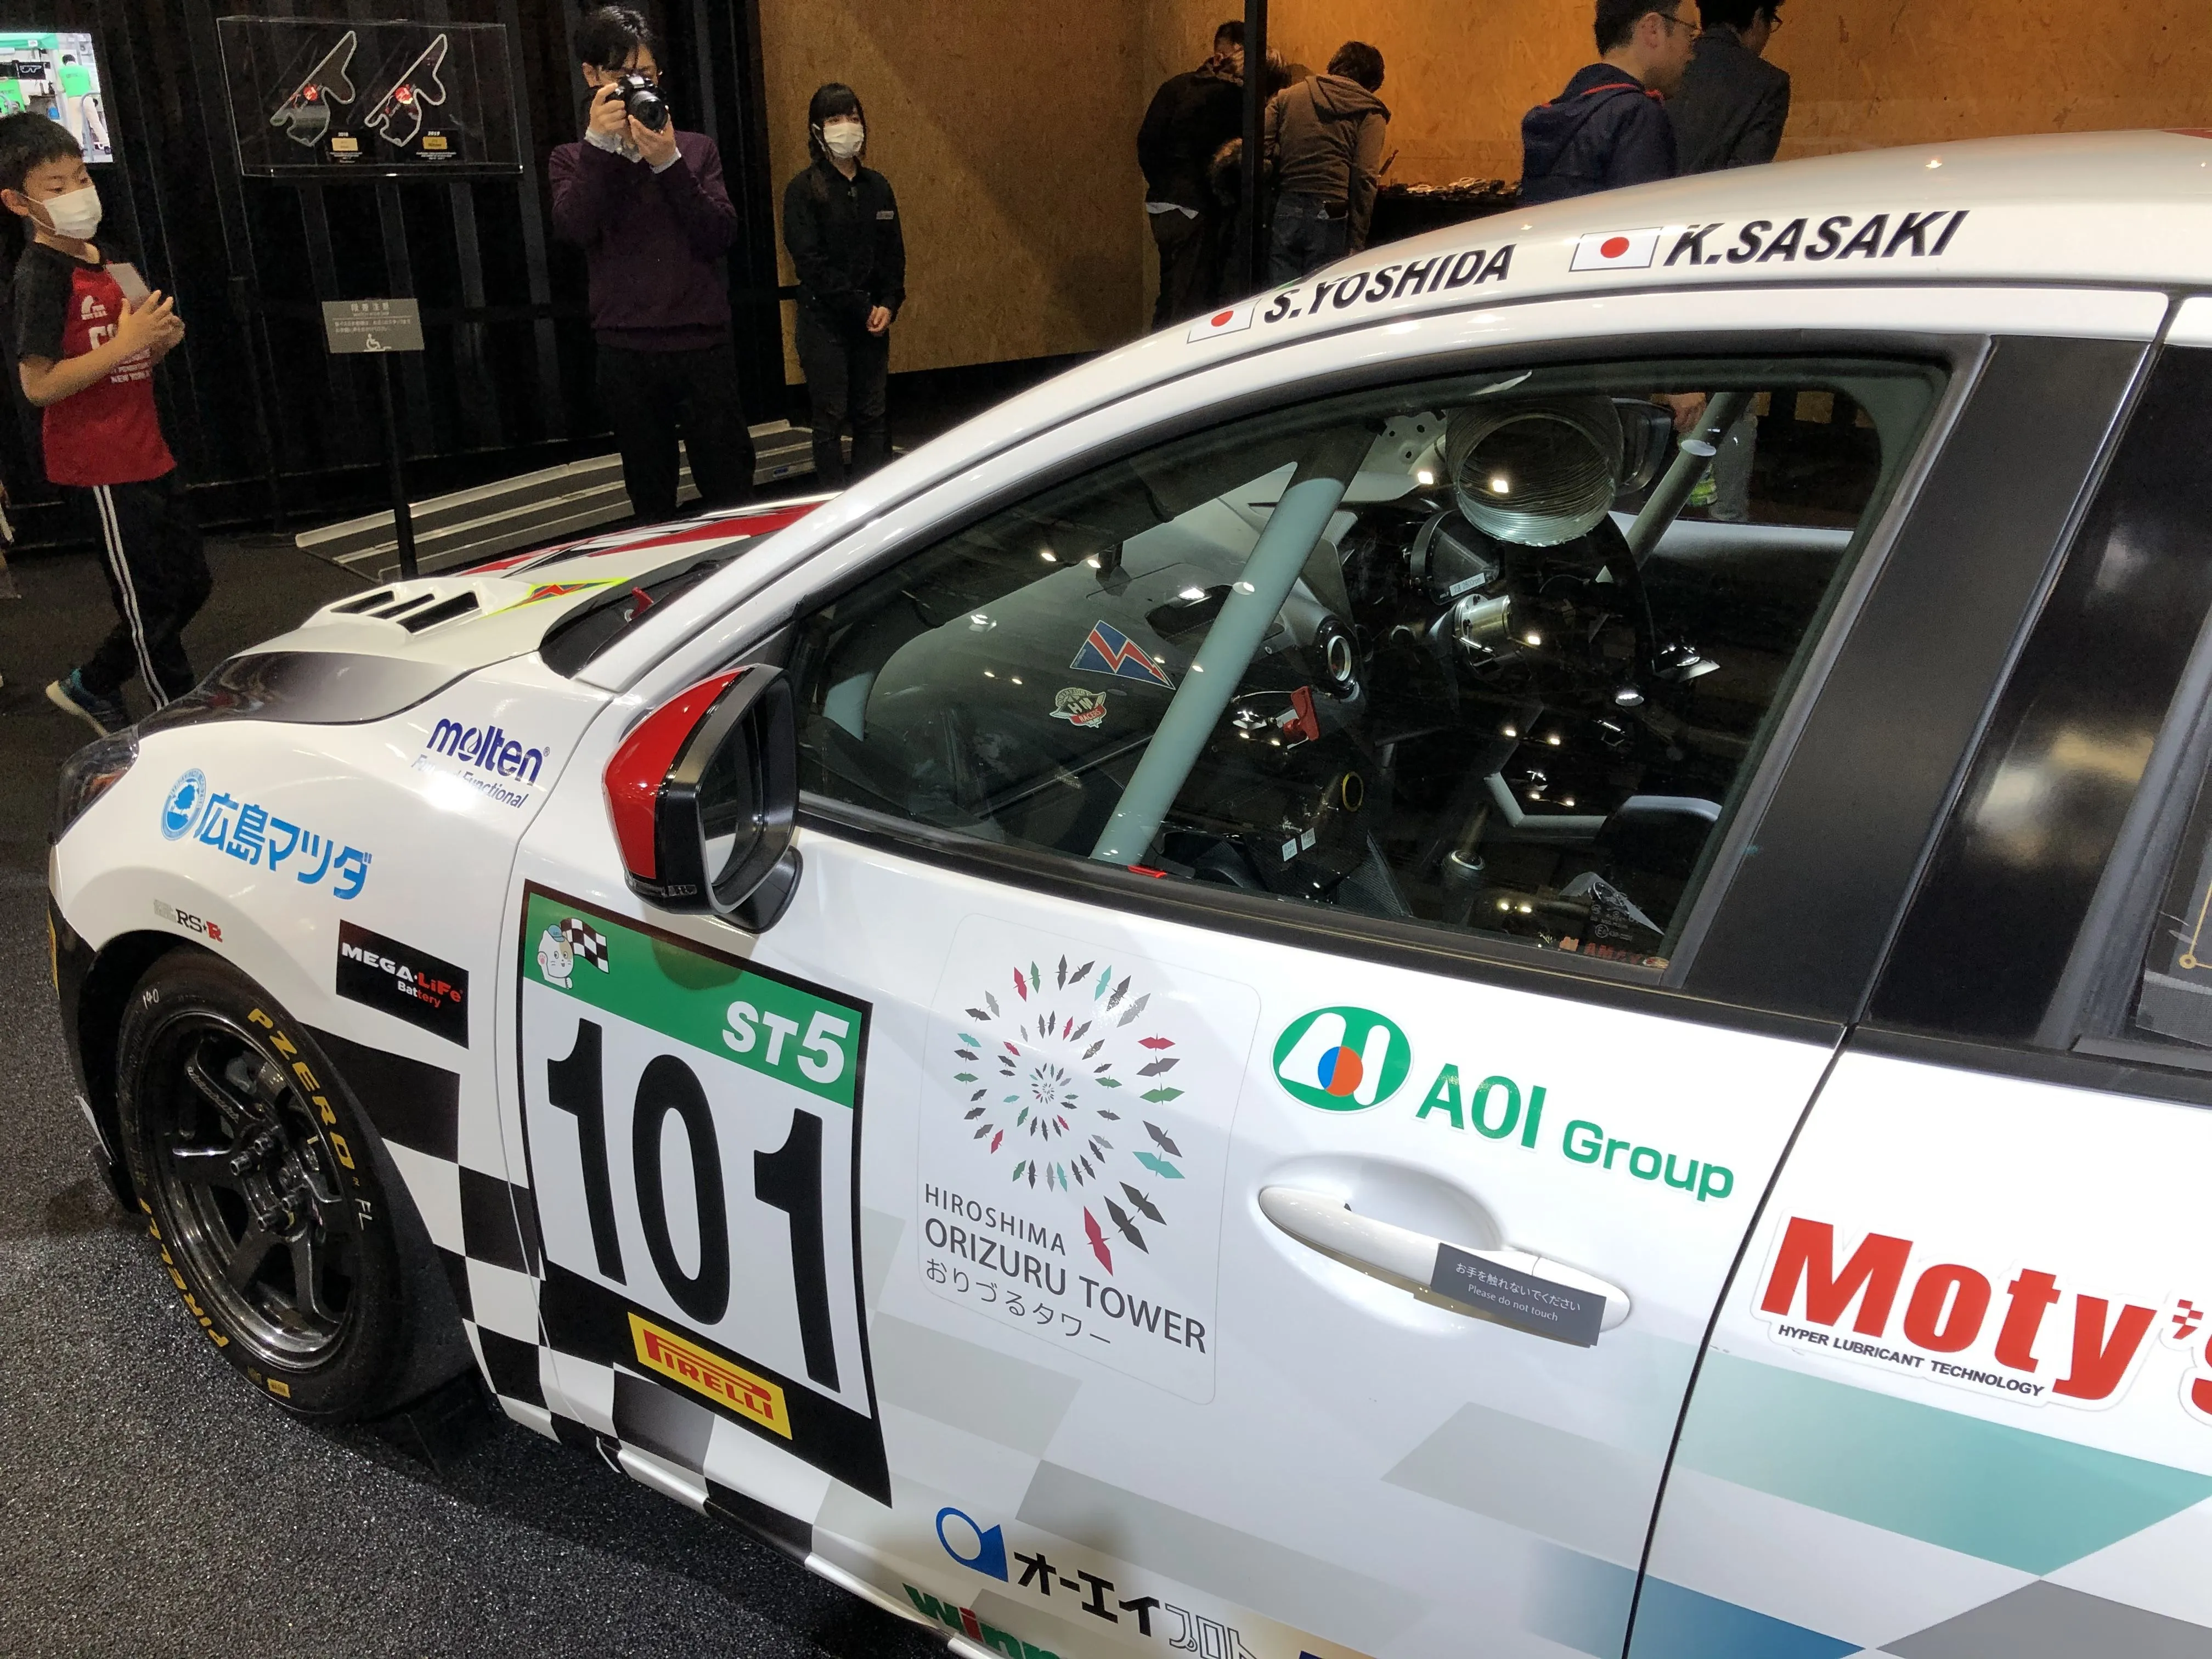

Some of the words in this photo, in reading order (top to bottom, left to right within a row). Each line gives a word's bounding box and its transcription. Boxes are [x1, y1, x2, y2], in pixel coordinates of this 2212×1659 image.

[1663, 210, 1970, 267] K.SASAKI
[1263, 243, 1516, 324] S.YOSHIDA
[1079, 709, 1102, 723] RACERS
[193, 793, 373, 900] 広島マツダ
[397, 980, 441, 1008] Battery
[722, 1000, 850, 1084] ST5
[1415, 1063, 1547, 1150] AOI
[1562, 1119, 1735, 1203] Group
[548, 1018, 842, 1393] 101
[925, 1183, 1066, 1256] HIROSHIMA
[139, 1198, 230, 1348] PIRELLI
[926, 1218, 1066, 1296] ORIZURU
[1079, 1275, 1206, 1355] TOWER
[926, 1258, 1111, 1344] おりづるタワー
[1455, 1262, 1581, 1311] お手を触れないでください
[1468, 1284, 1496, 1301] Please
[1498, 1296, 1511, 1306] do
[1513, 1301, 1530, 1313] not
[1531, 1306, 1559, 1322] touch
[642, 1328, 775, 1421] PIRELLI
[1778, 1324, 1830, 1346] HYPER
[1833, 1336, 1925, 1369] LUBRICANT
[1930, 1359, 2046, 1398] TECHNOLOGY
